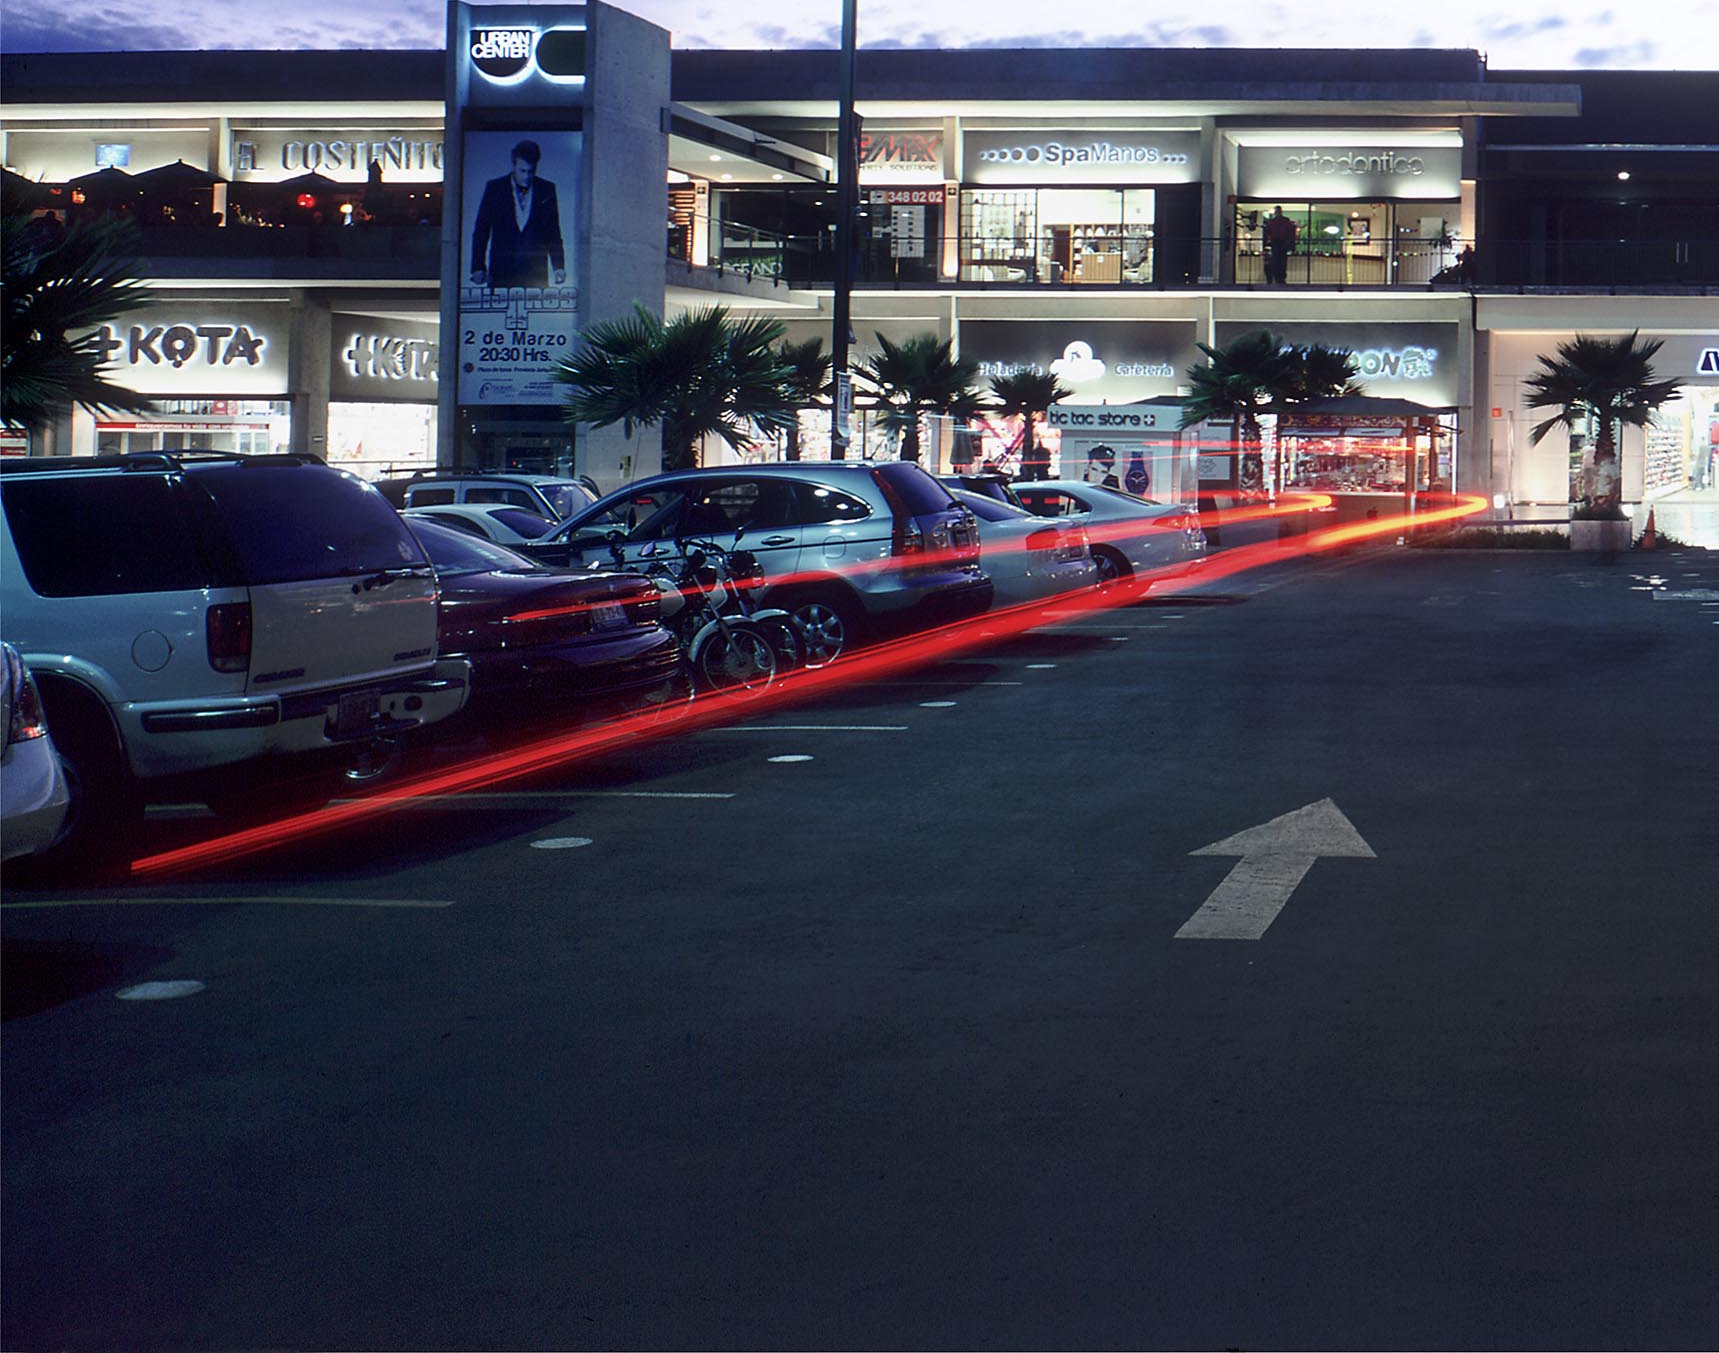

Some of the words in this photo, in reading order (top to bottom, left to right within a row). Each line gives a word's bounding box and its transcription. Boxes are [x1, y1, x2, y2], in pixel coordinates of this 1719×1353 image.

[480, 31, 531, 46] URBAN
[471, 44, 530, 59] CENTER
[239, 142, 264, 170] EL
[888, 191, 910, 203] 348
[912, 191, 927, 203] 02
[928, 191, 943, 203] 02
[464, 330, 475, 345] 2
[482, 331, 504, 345] de
[512, 332, 567, 345] Marzo
[523, 348, 552, 361] Hrs.
[1050, 412, 1068, 425] tic
[1071, 412, 1094, 425] tac
[1099, 413, 1140, 426] store
